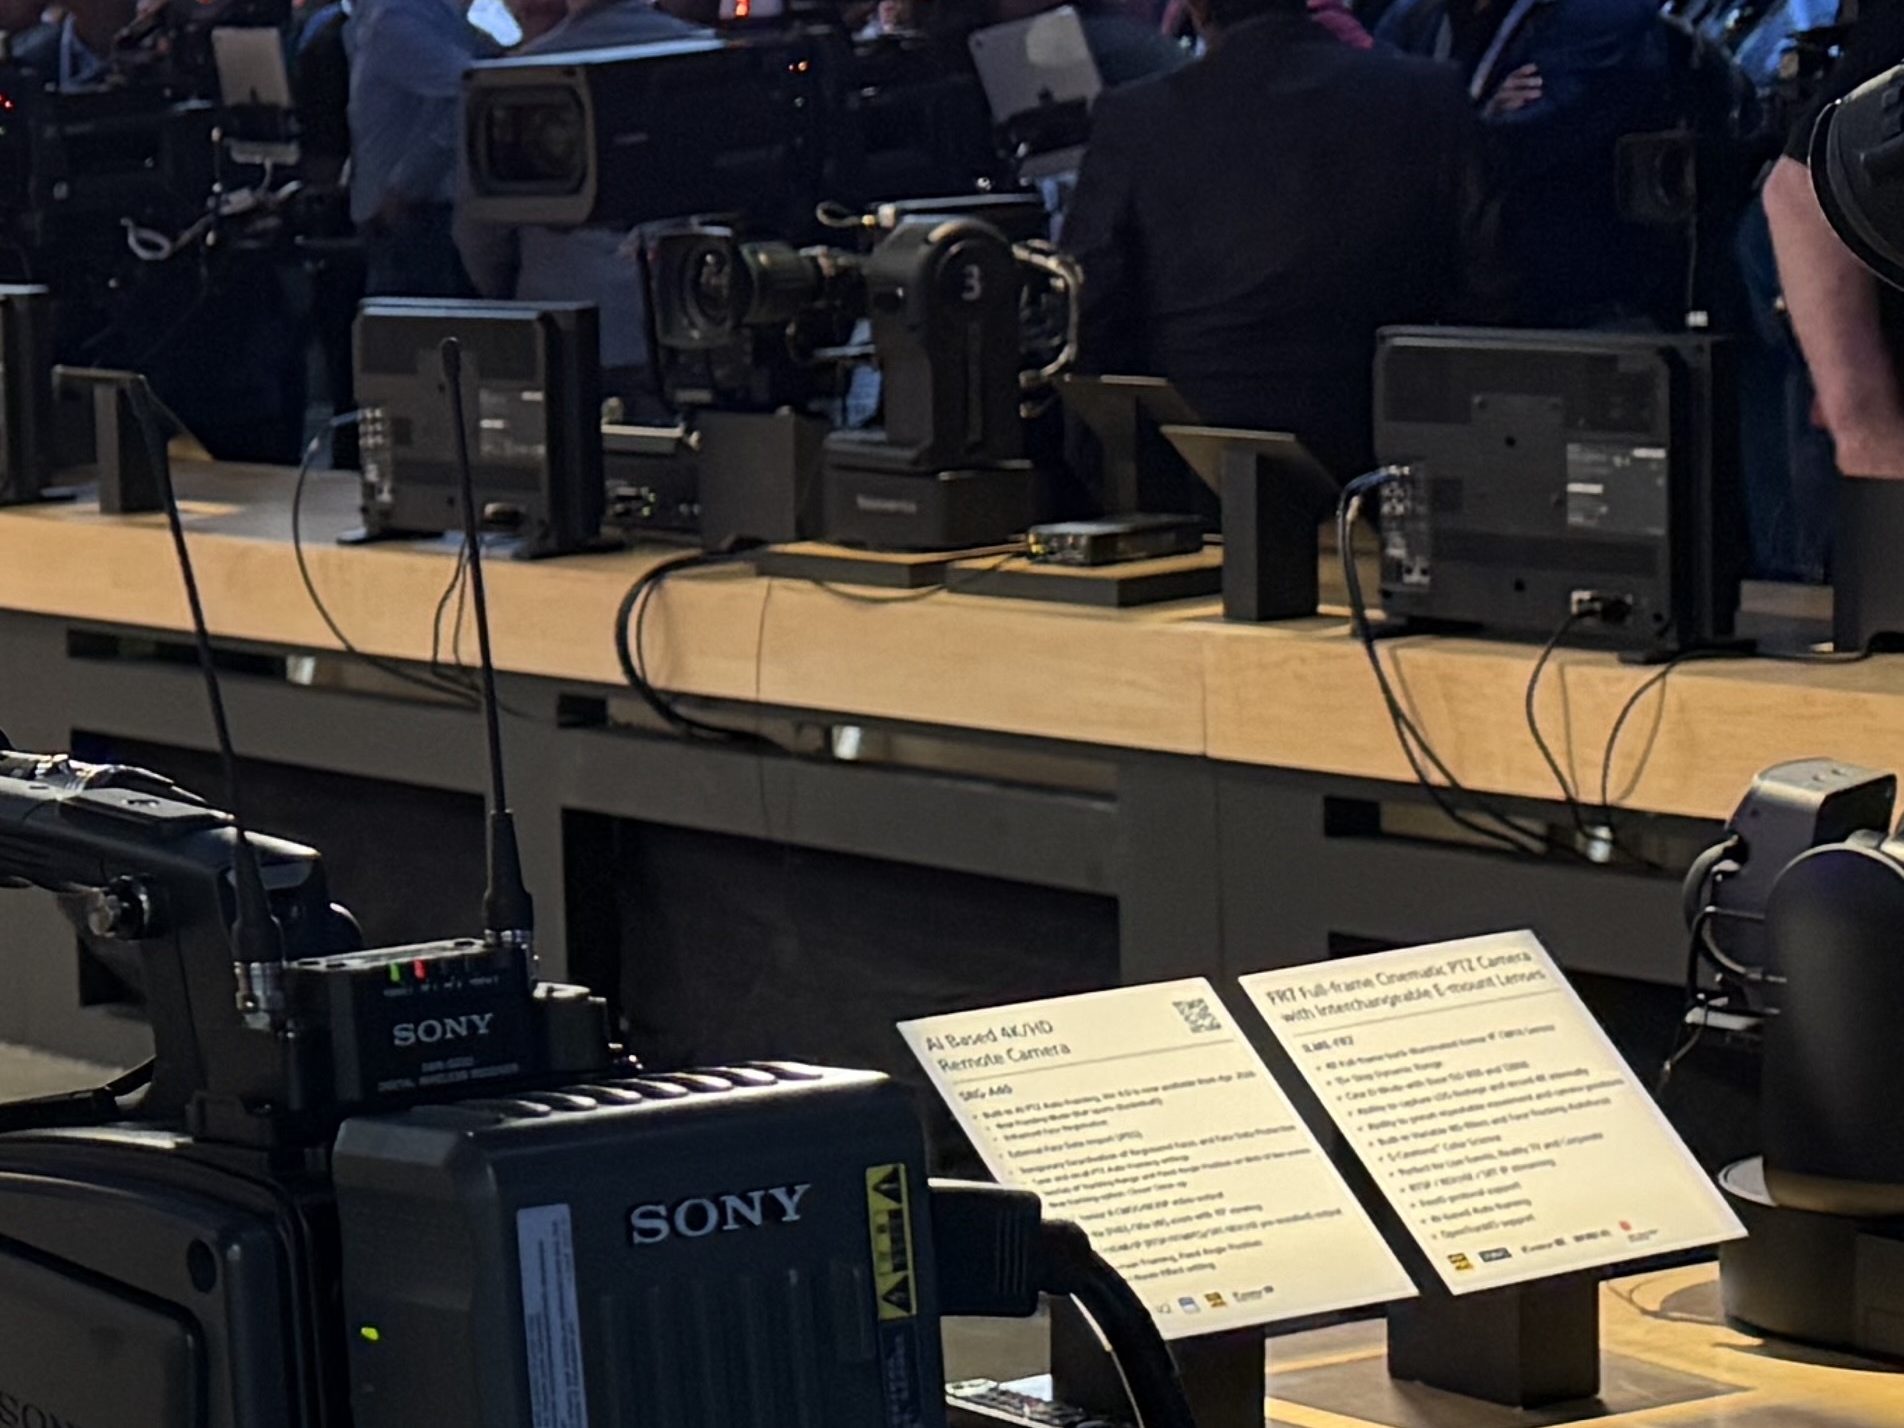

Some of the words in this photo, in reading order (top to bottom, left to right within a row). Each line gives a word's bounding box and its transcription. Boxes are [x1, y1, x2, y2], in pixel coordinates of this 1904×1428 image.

[960, 263, 983, 301] 3
[1264, 986, 1297, 1006] FR7
[1296, 976, 1375, 1000] Full-frame
[1374, 964, 1448, 986] Cinematic
[1445, 956, 1477, 974] PTZ
[1474, 950, 1533, 970] Camera
[1280, 1006, 1316, 1023] with
[1313, 986, 1433, 1017] Interchangeable
[1431, 975, 1497, 998] E-mount
[1494, 968, 1547, 987] Lenses
[392, 1012, 494, 1047] SONY
[924, 1035, 945, 1052] AI
[943, 1026, 998, 1049] Based
[999, 1018, 1054, 1039] 4K/HD
[935, 1052, 1005, 1073] Remote
[1004, 1042, 1072, 1063] Camera
[630, 1182, 812, 1248] SONY
